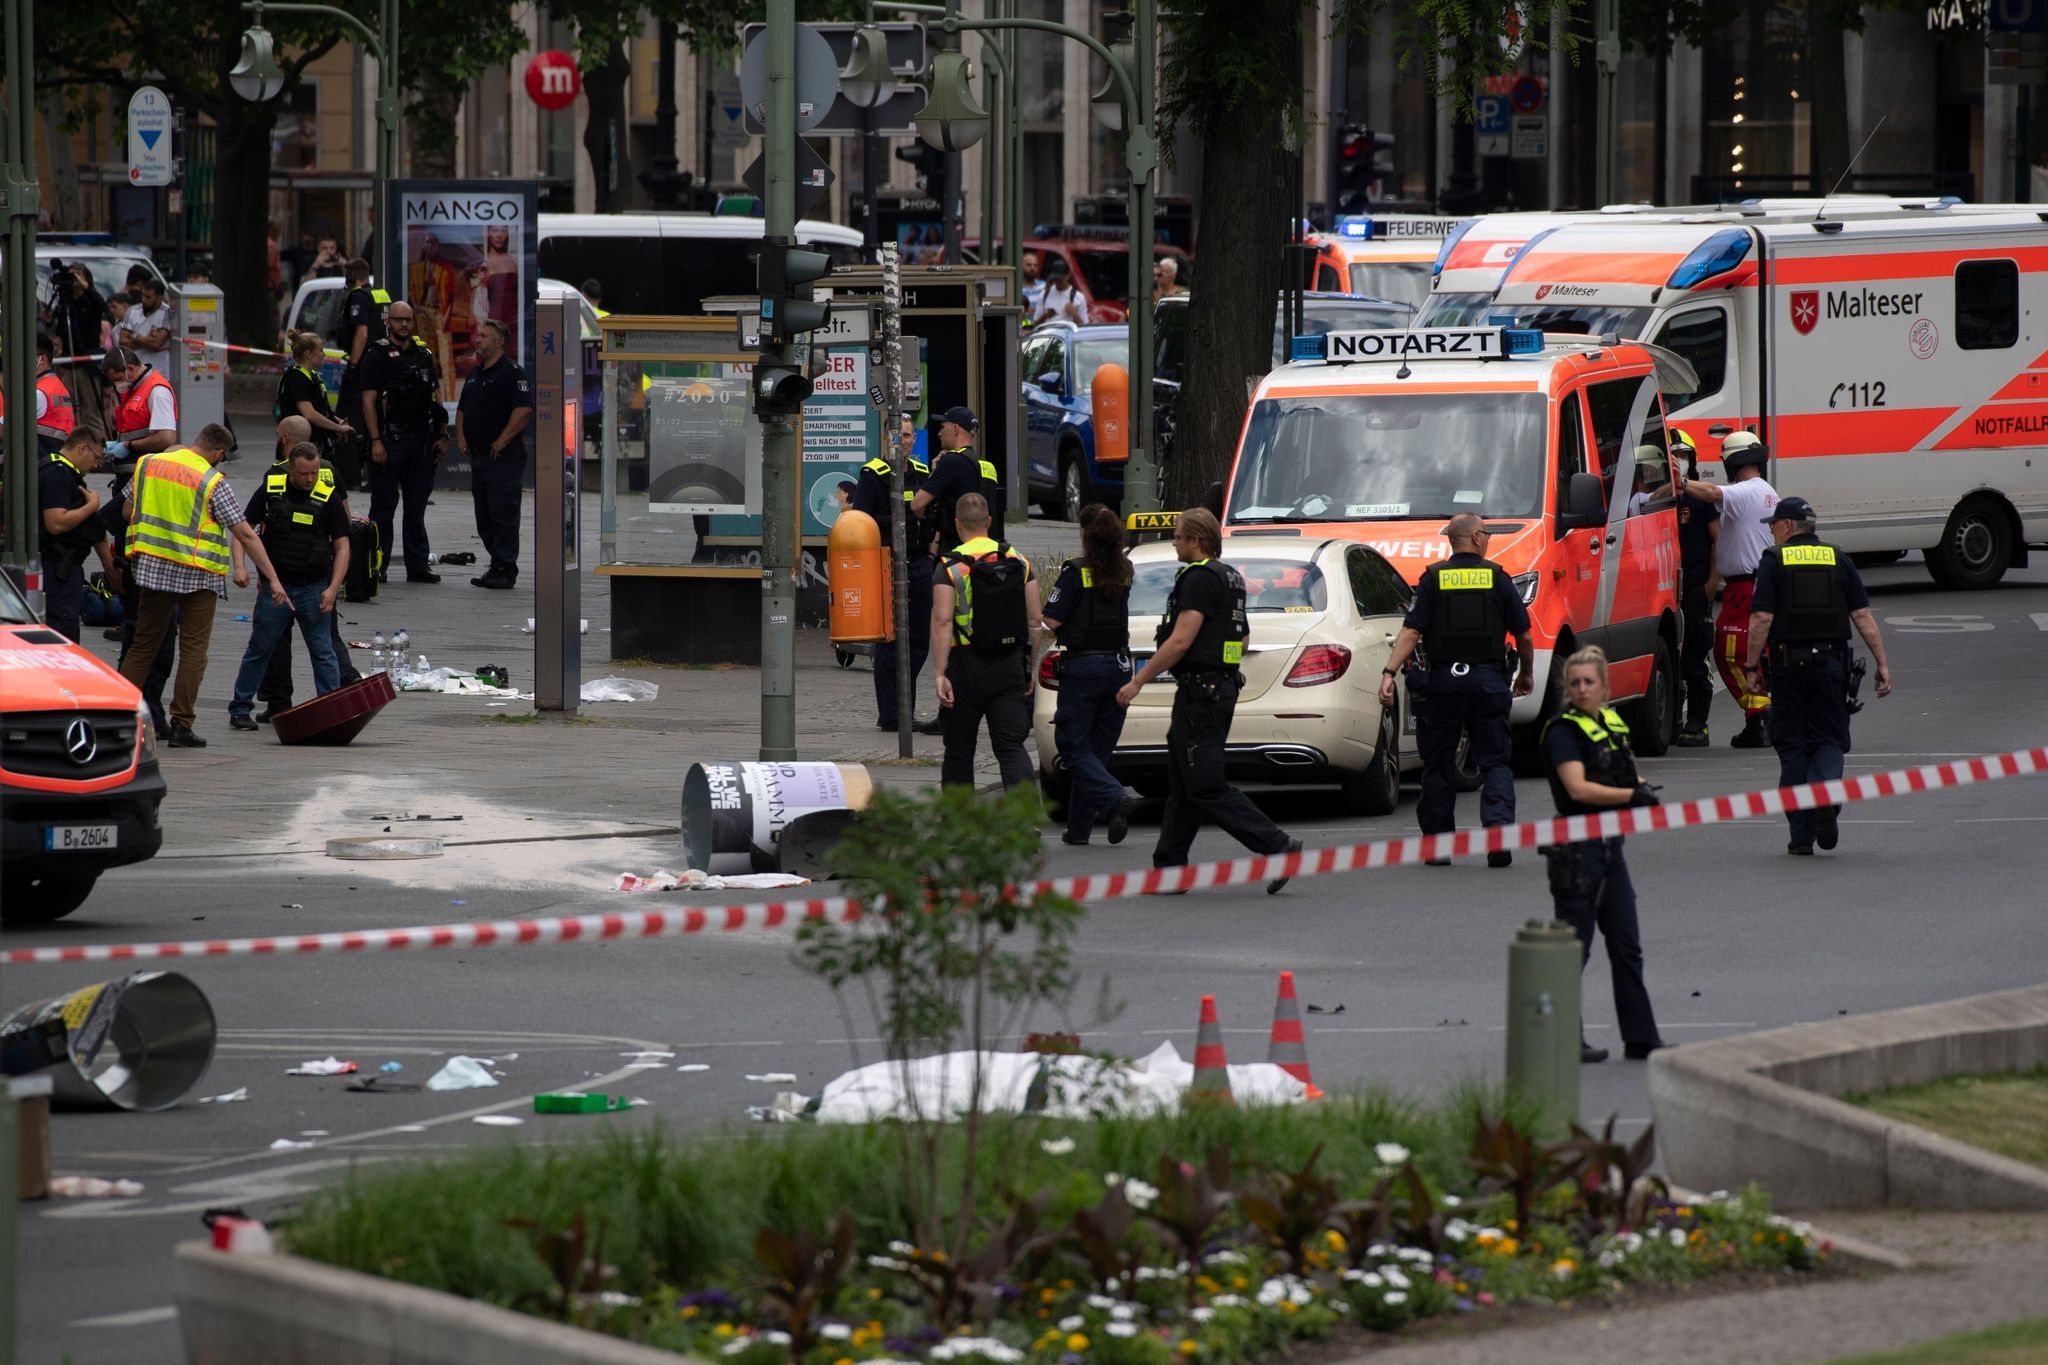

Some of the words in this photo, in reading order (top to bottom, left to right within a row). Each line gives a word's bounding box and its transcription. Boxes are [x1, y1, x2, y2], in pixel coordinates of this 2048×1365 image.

[144, 94, 155, 105] 13
[407, 200, 519, 220] MANGO
[1551, 285, 1600, 298] Malteser
[1826, 287, 1923, 319] Malteser
[1333, 332, 1495, 356] NOTARZT
[1848, 381, 1886, 408] 112
[803, 422, 852, 430] SMARTPHONE
[818, 438, 839, 446] NACH
[1702, 469, 1715, 478] des
[1356, 506, 1371, 514] NEF
[1785, 547, 1833, 562] POLIZEI
[1442, 571, 1490, 587] POLIZEI
[64, 829, 73, 846] B
[80, 828, 109, 846] 2604
